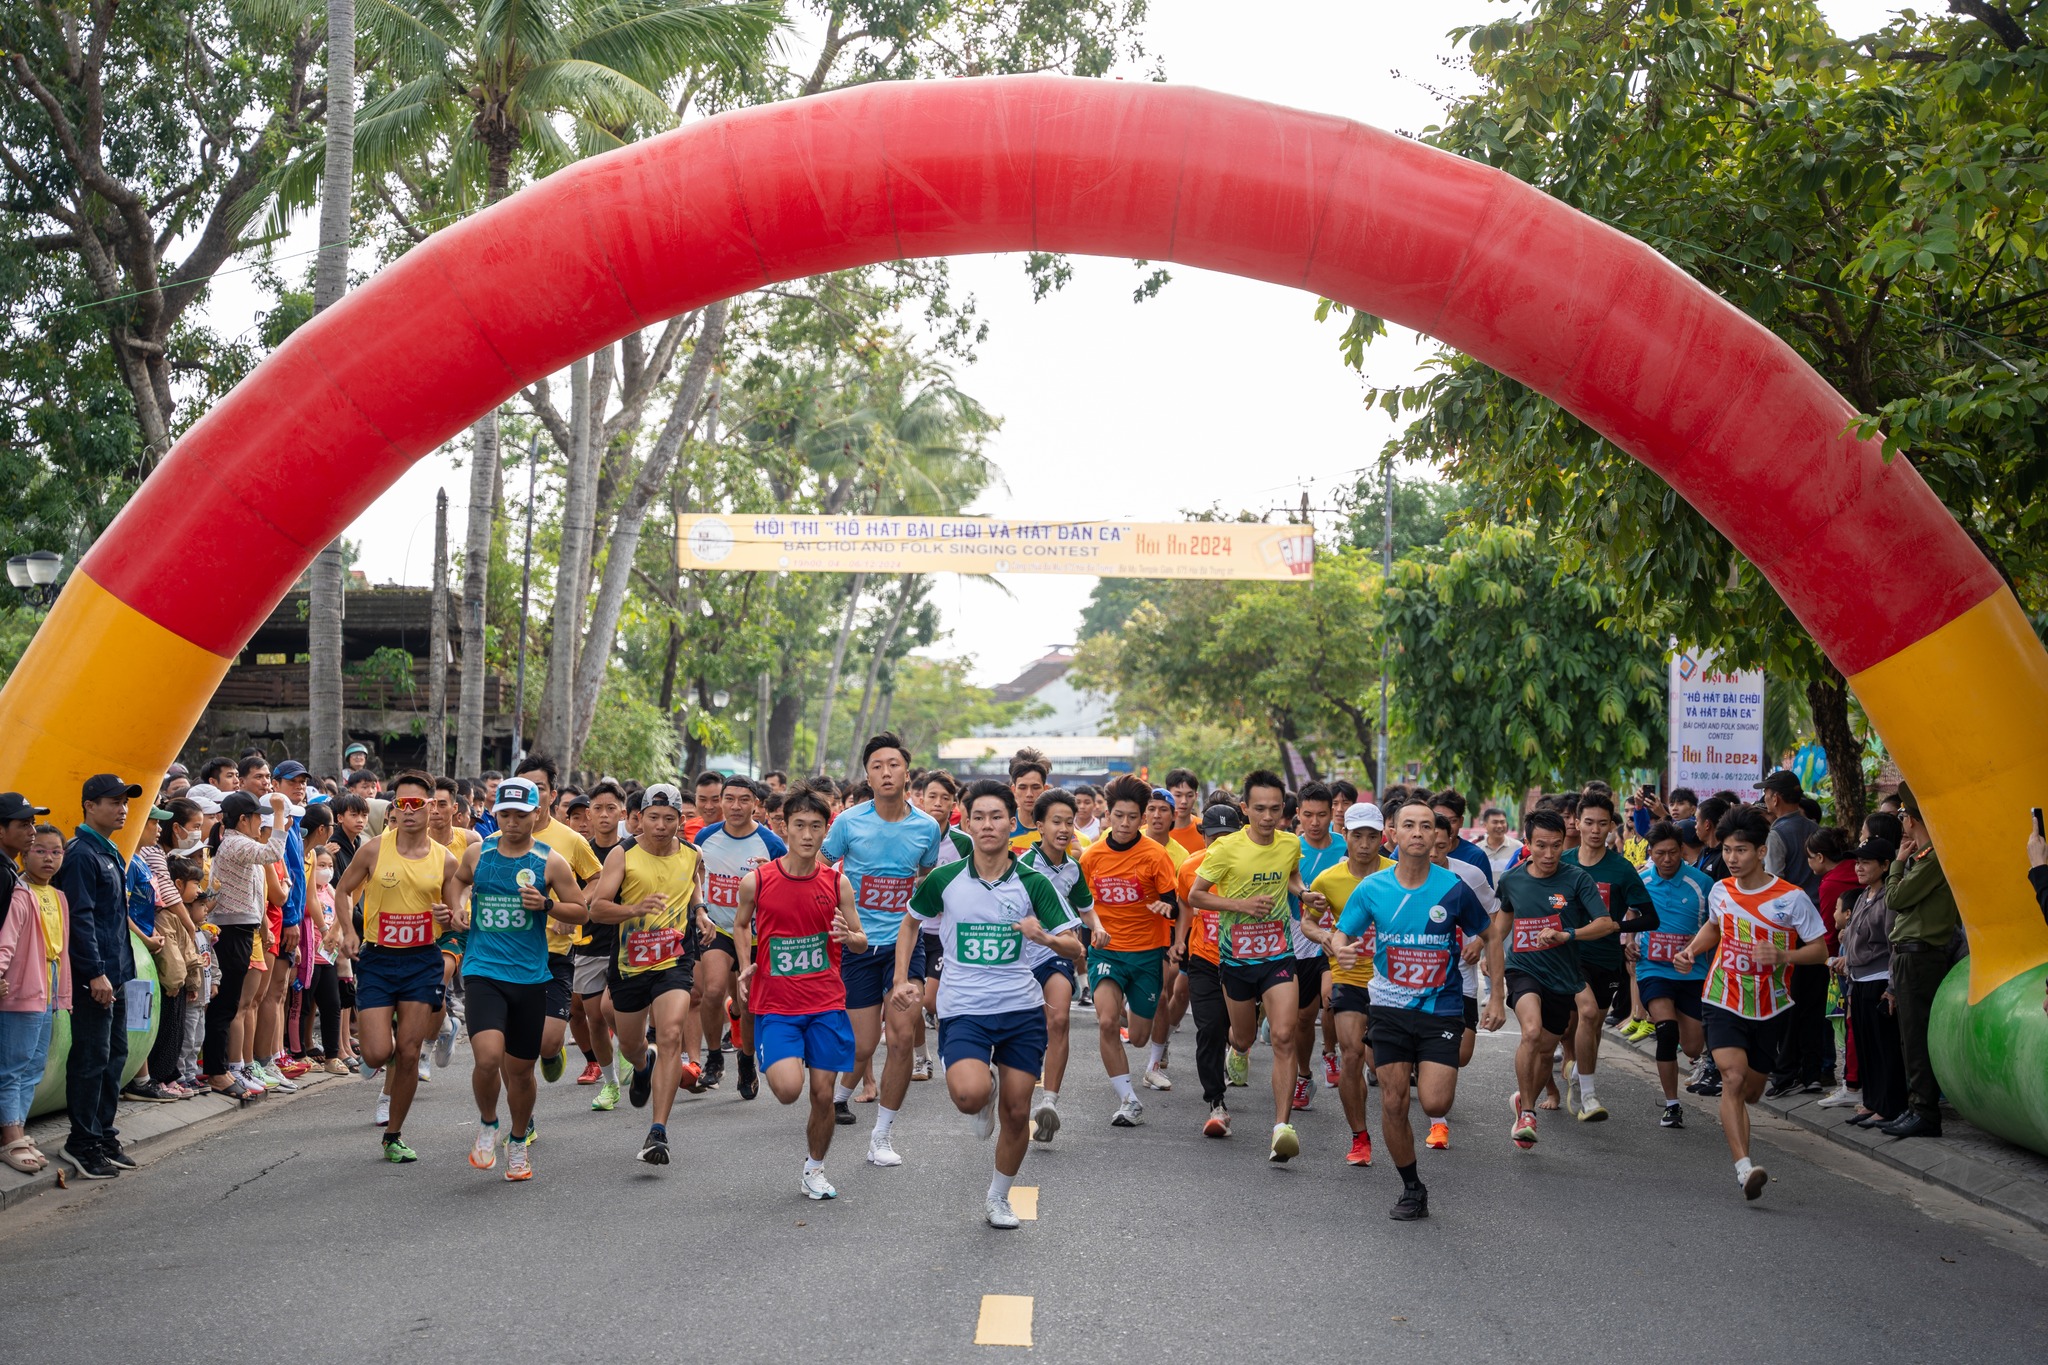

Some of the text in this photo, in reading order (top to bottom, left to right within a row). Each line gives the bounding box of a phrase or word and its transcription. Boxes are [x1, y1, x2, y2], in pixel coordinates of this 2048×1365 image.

[790, 521, 818, 535] THI
[861, 541, 895, 553] AND
[901, 543, 943, 553] FOLK
[949, 543, 1017, 555] SINGING
[1023, 545, 1099, 557] CONTEST
[1190, 535, 1232, 556] 2024
[1708, 722, 1720, 730] AND
[1736, 723, 1759, 731] SINGING
[1708, 732, 1734, 740] CONTEST
[1725, 753, 1758, 765] 2024
[1711, 772, 1720, 780] 04
[1725, 772, 1759, 781] 06/12/2024
[1252, 871, 1283, 882] RUN
[712, 886, 740, 904] 21
[864, 889, 908, 908] 222
[1100, 887, 1139, 903] 238
[481, 908, 526, 929] 333
[383, 924, 425, 944] 201
[1403, 933, 1415, 944] SA
[1517, 930, 1540, 949] 25
[634, 940, 676, 962] 211
[964, 938, 1016, 961] 352
[1238, 934, 1281, 955] 232
[777, 947, 824, 972] 346
[1392, 961, 1441, 985] 227
